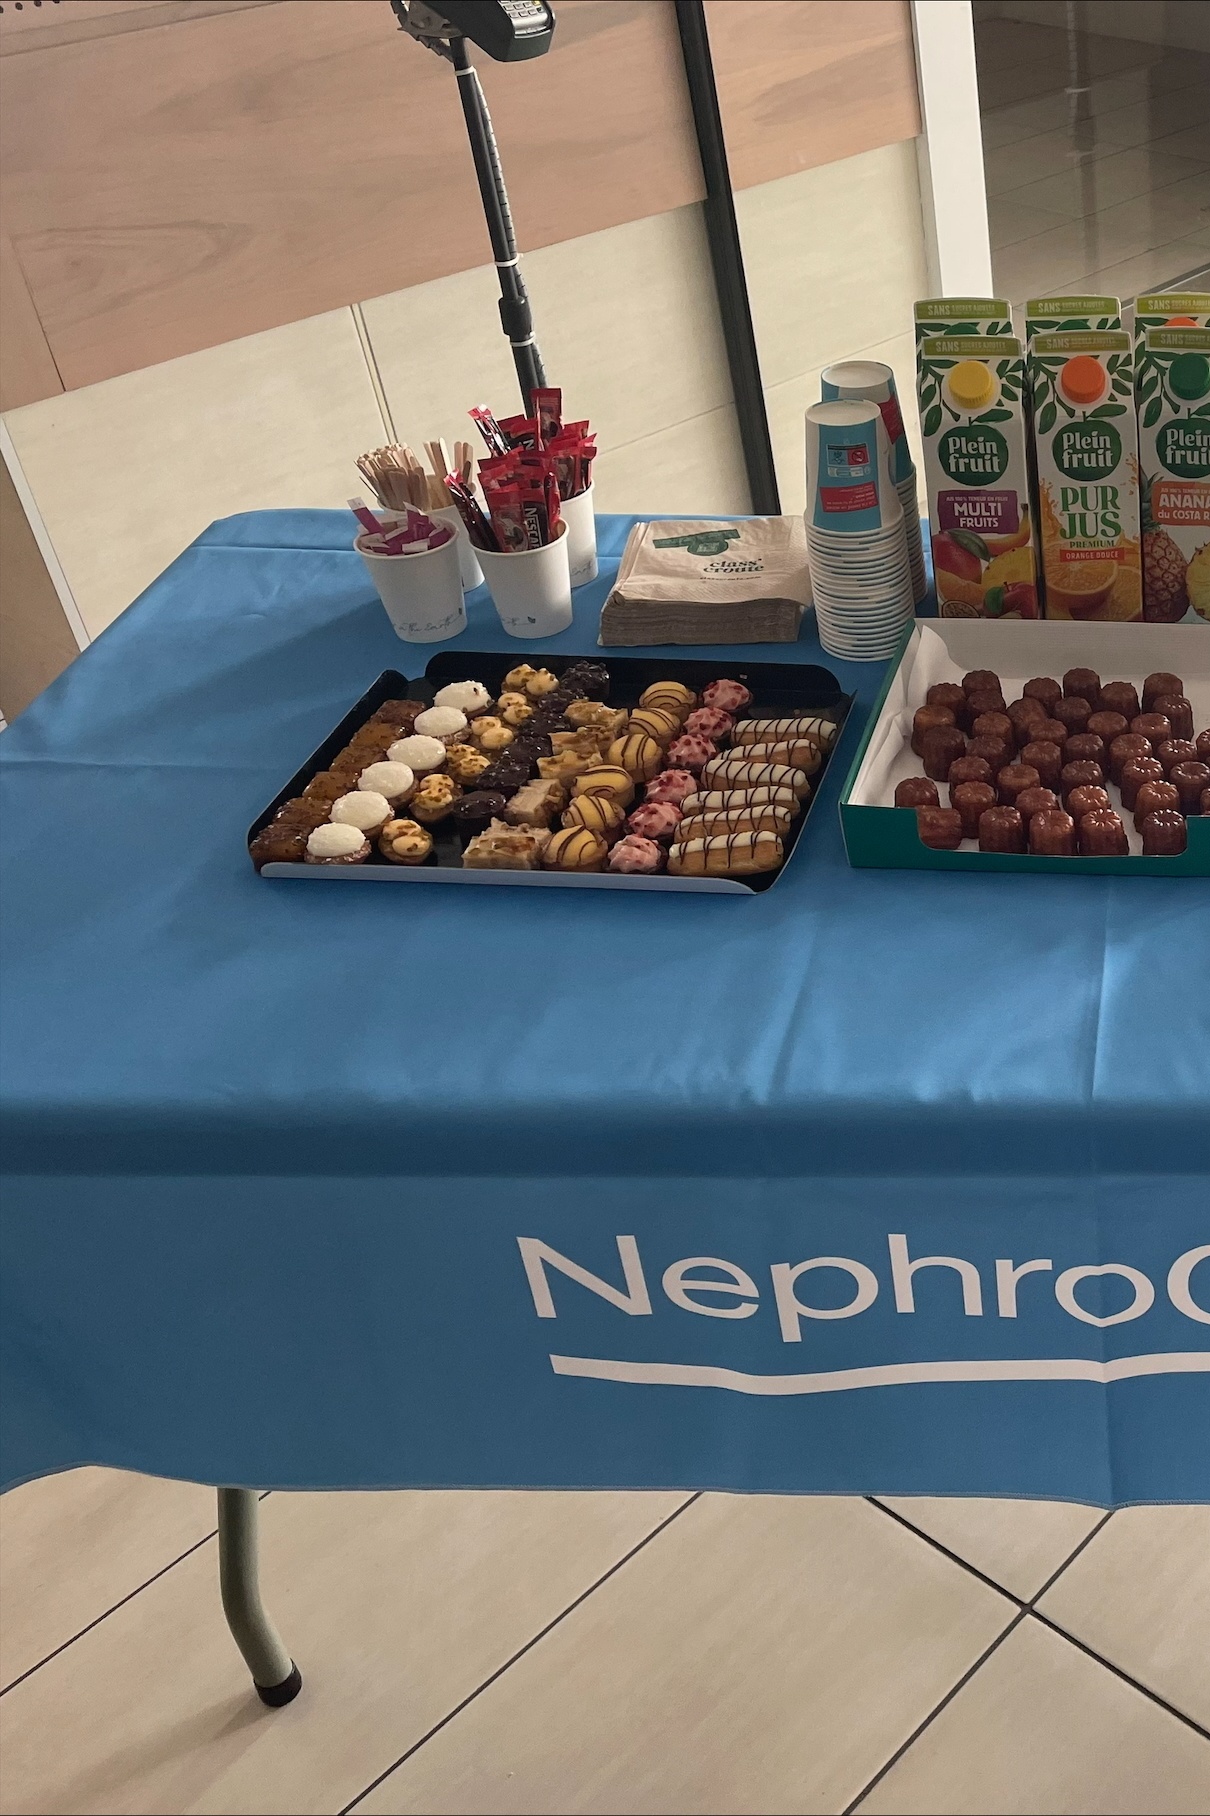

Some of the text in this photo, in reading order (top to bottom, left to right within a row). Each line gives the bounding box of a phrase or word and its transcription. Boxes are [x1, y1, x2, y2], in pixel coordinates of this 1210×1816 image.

[927, 304, 950, 316] SANS
[1038, 302, 1061, 313] SANS
[1148, 300, 1171, 311] SANS
[1046, 338, 1070, 349] SANS
[1160, 333, 1184, 345] SANS
[935, 341, 960, 352] SANS
[947, 436, 998, 454] Plein
[1062, 430, 1112, 450] Plein
[948, 453, 1000, 473] fruit
[1062, 449, 1114, 469] fruit
[1060, 485, 1121, 512] PUR
[953, 502, 1002, 516] MULTI
[1157, 509, 1170, 519] du
[1172, 509, 1201, 520] COSTA
[959, 517, 999, 528] FRUITS
[1060, 511, 1122, 539] JUS
[1069, 540, 1115, 548] PREMIUM
[1065, 550, 1119, 560] ORANGE DOUCE
